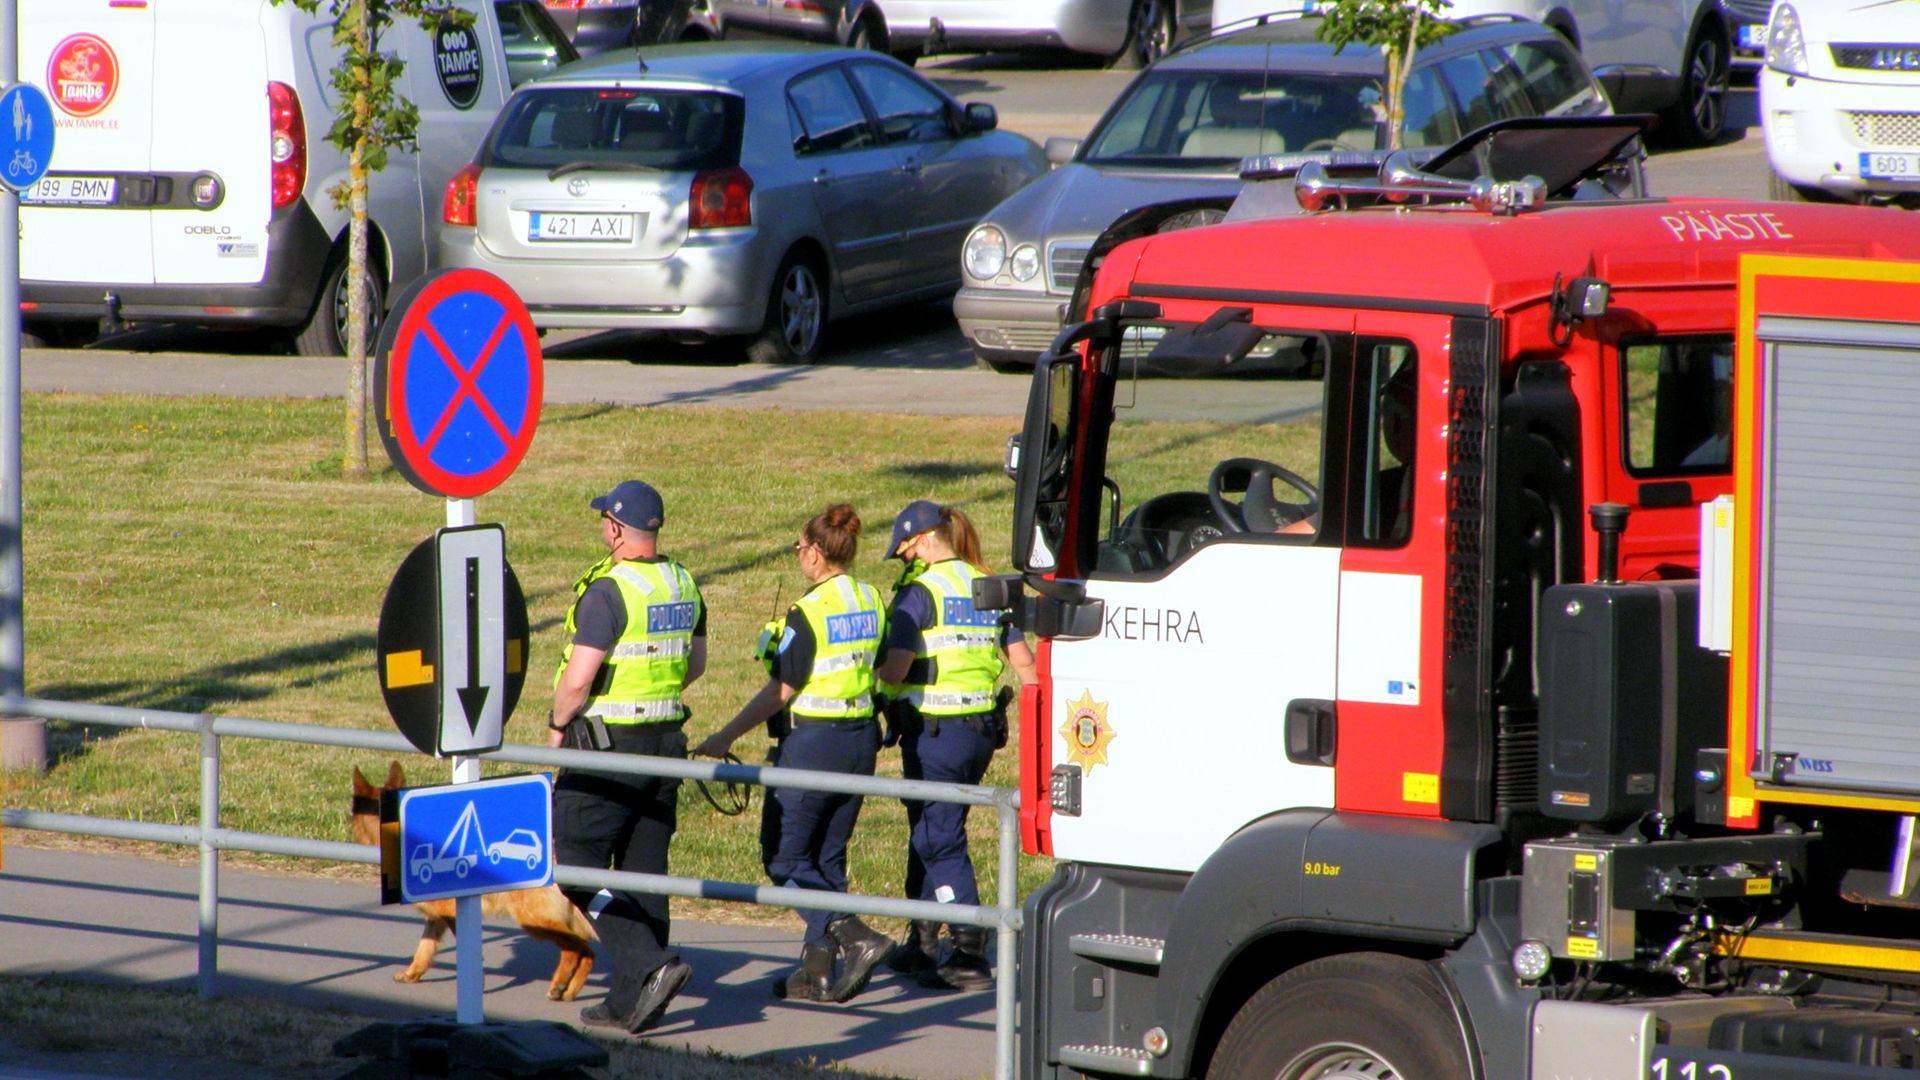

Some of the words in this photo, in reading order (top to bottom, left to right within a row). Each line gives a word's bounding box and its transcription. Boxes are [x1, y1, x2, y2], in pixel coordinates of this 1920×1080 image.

[438, 49, 479, 74] TAMPE
[58, 80, 106, 102] Tampe
[1877, 156, 1906, 173] 603
[36, 180, 60, 197] 199
[71, 180, 109, 197] BMN
[184, 225, 231, 235] DOBLO
[547, 218, 576, 236] 421
[590, 218, 623, 236] AXI
[1661, 209, 1794, 242] PÄÄSTE
[1105, 605, 1204, 644] KEHRA
[1304, 862, 1321, 875] 9.0
[1322, 862, 1341, 876] bar
